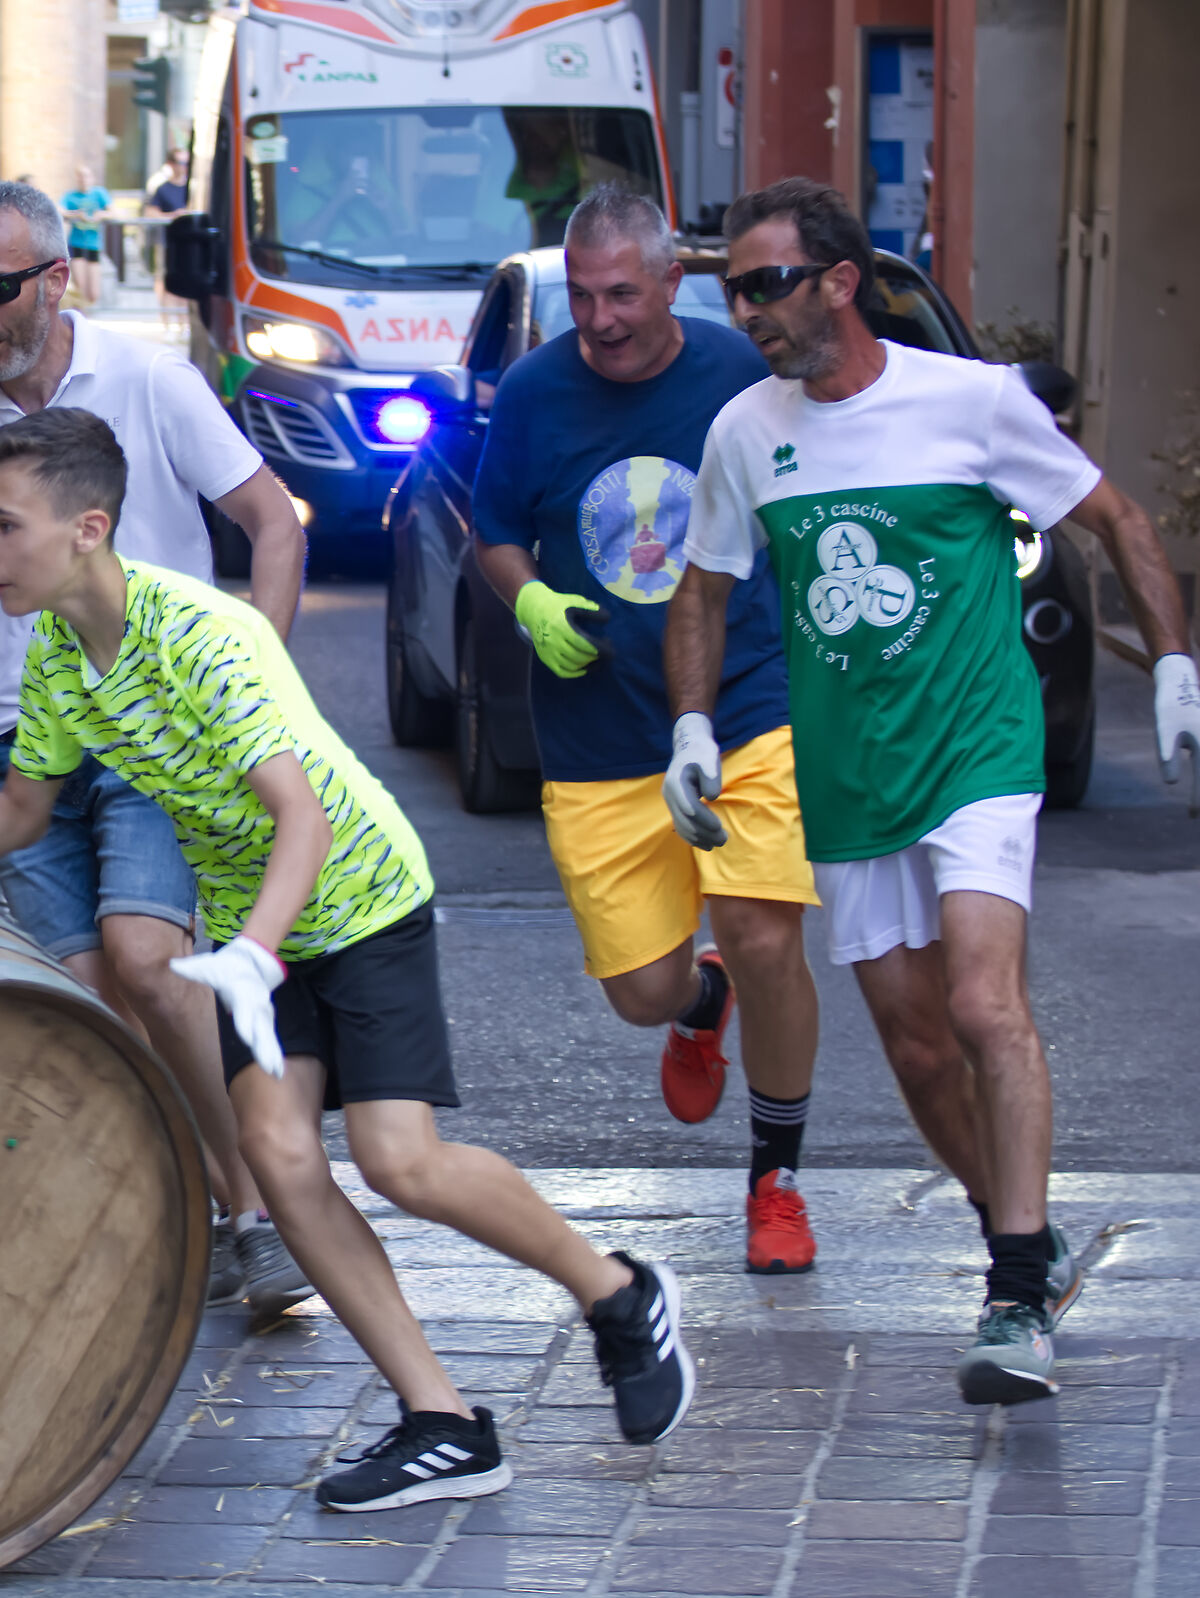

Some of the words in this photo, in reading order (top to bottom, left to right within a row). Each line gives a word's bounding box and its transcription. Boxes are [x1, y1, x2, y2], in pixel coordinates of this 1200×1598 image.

[582, 470, 621, 513] BOTTI
[789, 517, 813, 540] Le
[813, 505, 826, 523] 3
[830, 502, 899, 528] cascine
[583, 527, 609, 575] CORSA
[831, 529, 867, 572] A
[918, 557, 936, 583] Le
[921, 588, 940, 600] 3
[881, 605, 932, 661] cascine
[825, 651, 850, 671] Le
